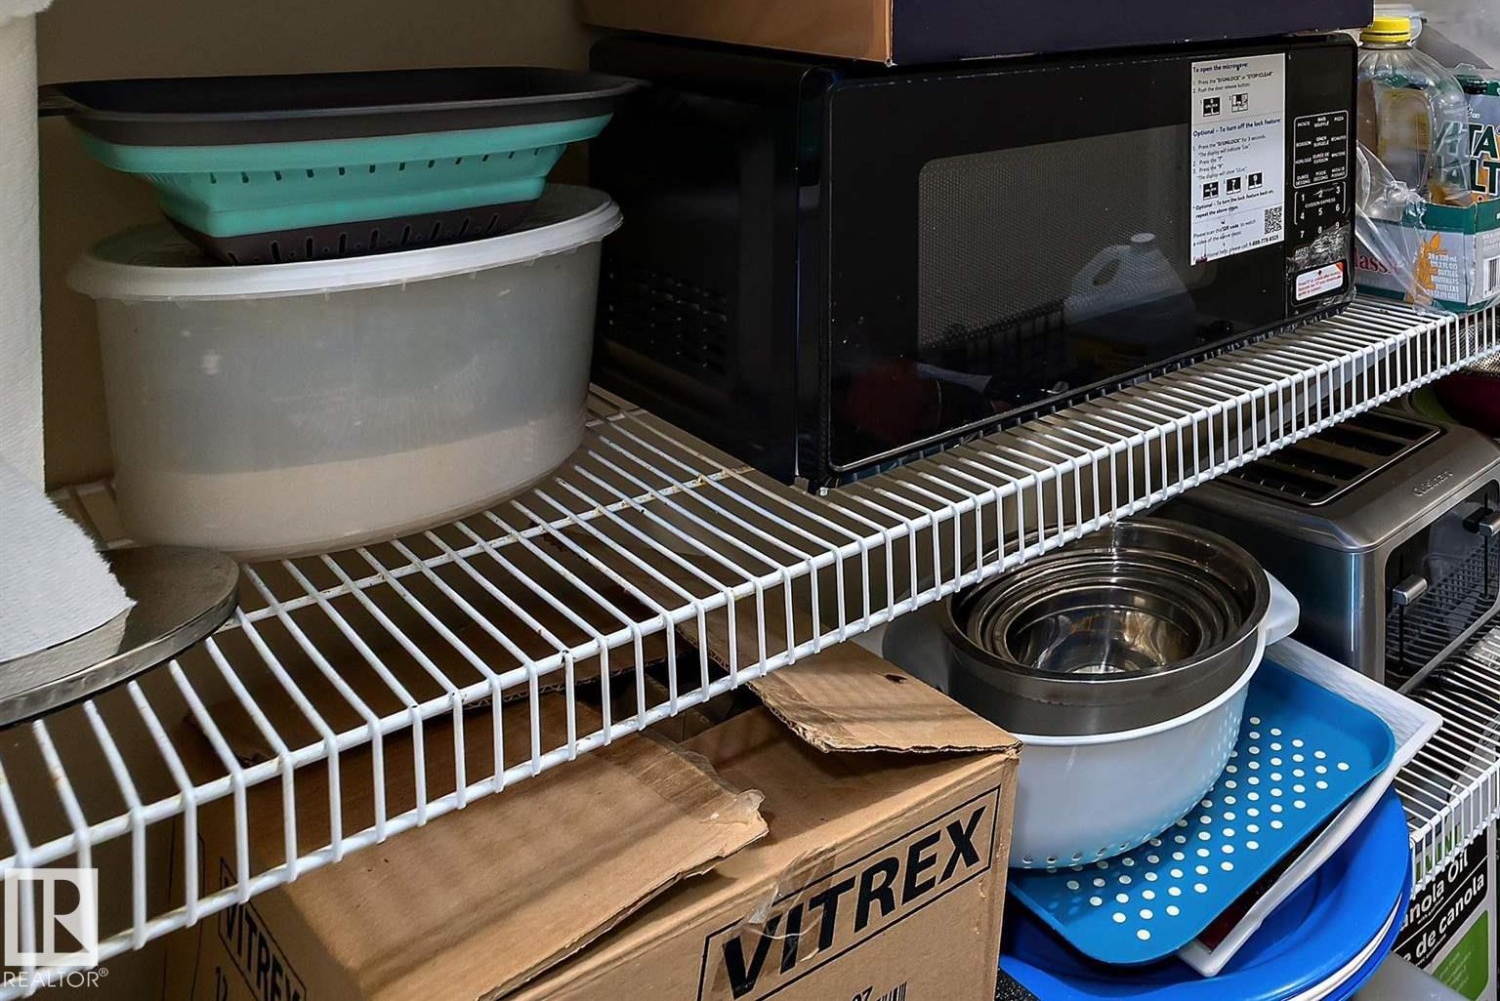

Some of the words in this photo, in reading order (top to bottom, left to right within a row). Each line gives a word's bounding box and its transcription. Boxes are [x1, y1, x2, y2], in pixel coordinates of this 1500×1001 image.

[721, 805, 987, 1000] VITREX
[1447, 848, 1469, 883] Oil
[1415, 931, 1437, 958] de
[1438, 873, 1485, 935] canola
